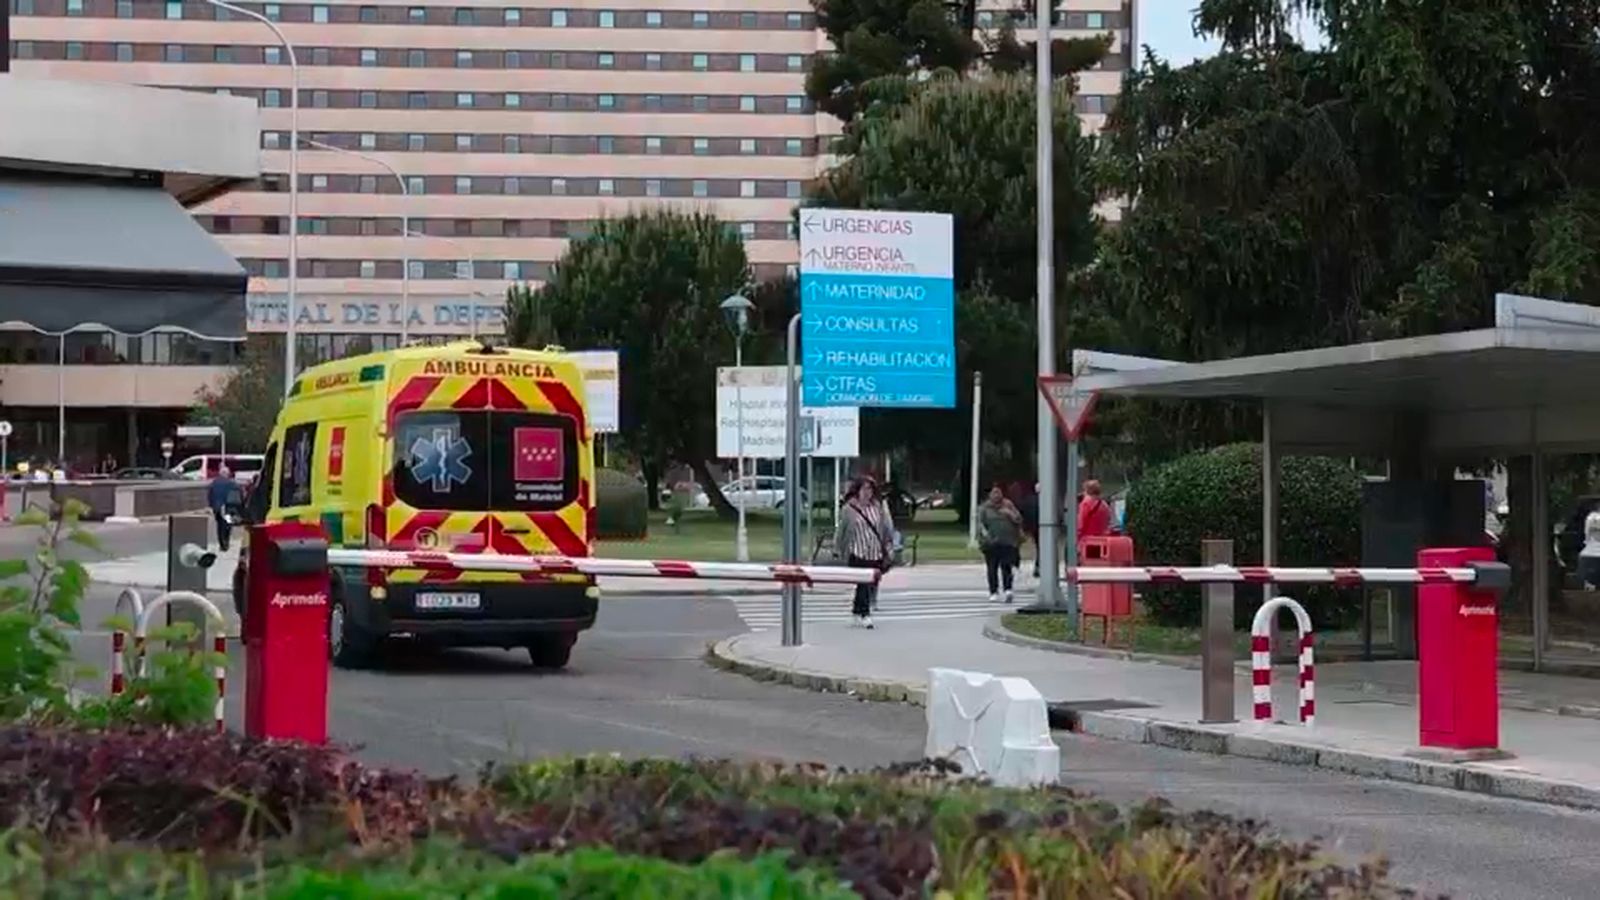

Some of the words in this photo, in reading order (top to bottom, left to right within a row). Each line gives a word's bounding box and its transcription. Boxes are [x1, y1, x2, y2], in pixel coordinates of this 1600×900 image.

[822, 218, 913, 235] URGENCIAS
[823, 246, 904, 261] URGENCIA
[824, 284, 926, 300] MATERNIDAD
[342, 303, 381, 325] DE
[387, 303, 425, 325] LA
[825, 316, 919, 333] CONSULTAS
[826, 350, 951, 368] REHABILITACION
[424, 359, 555, 378] AMBULANCIA
[826, 376, 877, 392] CTFAS
